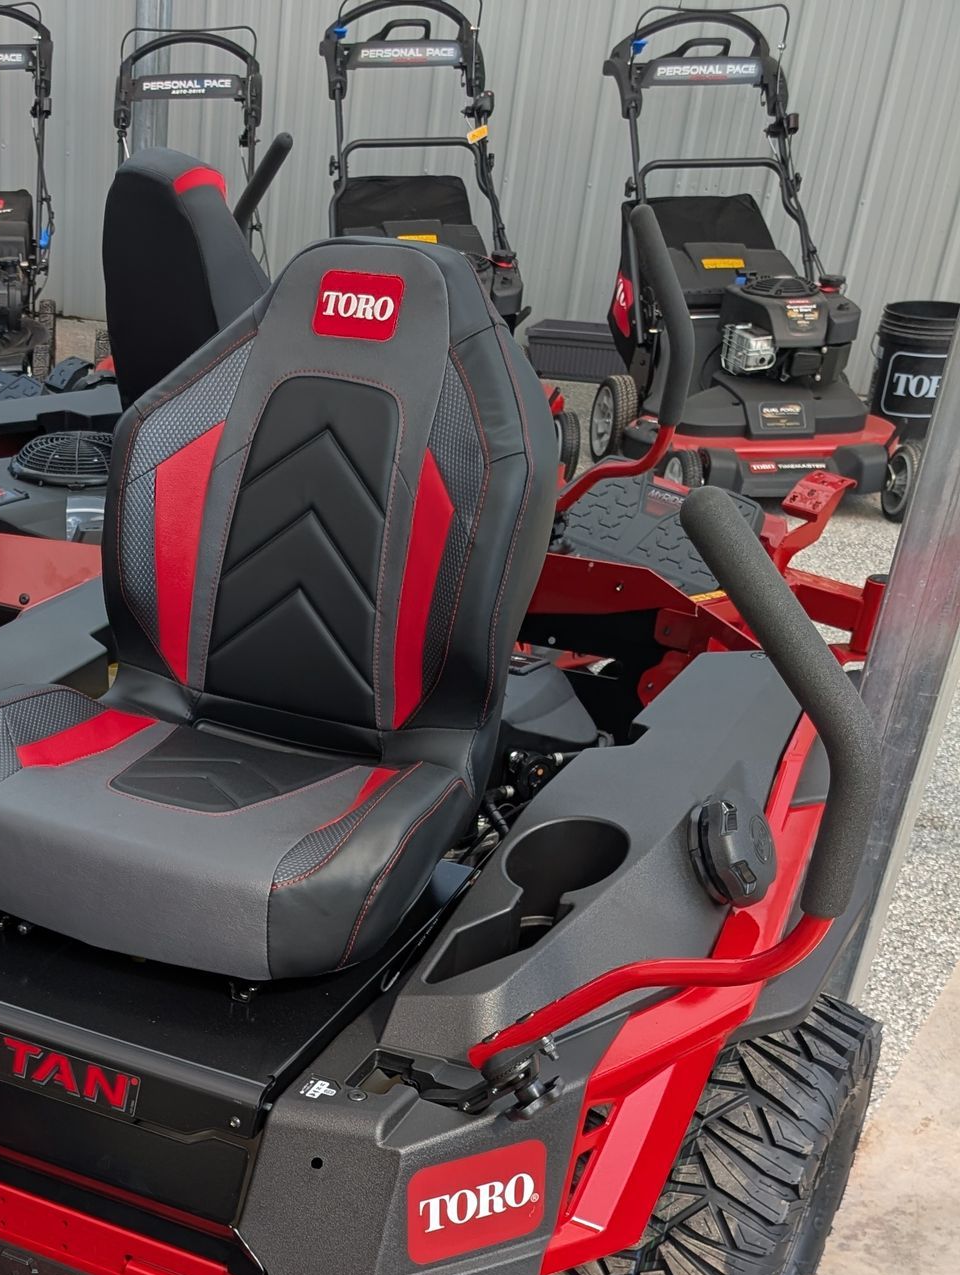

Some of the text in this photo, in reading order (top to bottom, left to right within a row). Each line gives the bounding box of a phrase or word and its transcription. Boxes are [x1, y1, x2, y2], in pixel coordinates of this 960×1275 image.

[360, 47, 455, 59] PERSONAL PACE
[656, 63, 756, 77] PERSONAL PACE
[142, 79, 233, 91] PERSONAL PACE
[322, 291, 395, 321] TORO
[419, 1173, 535, 1233] TORO
